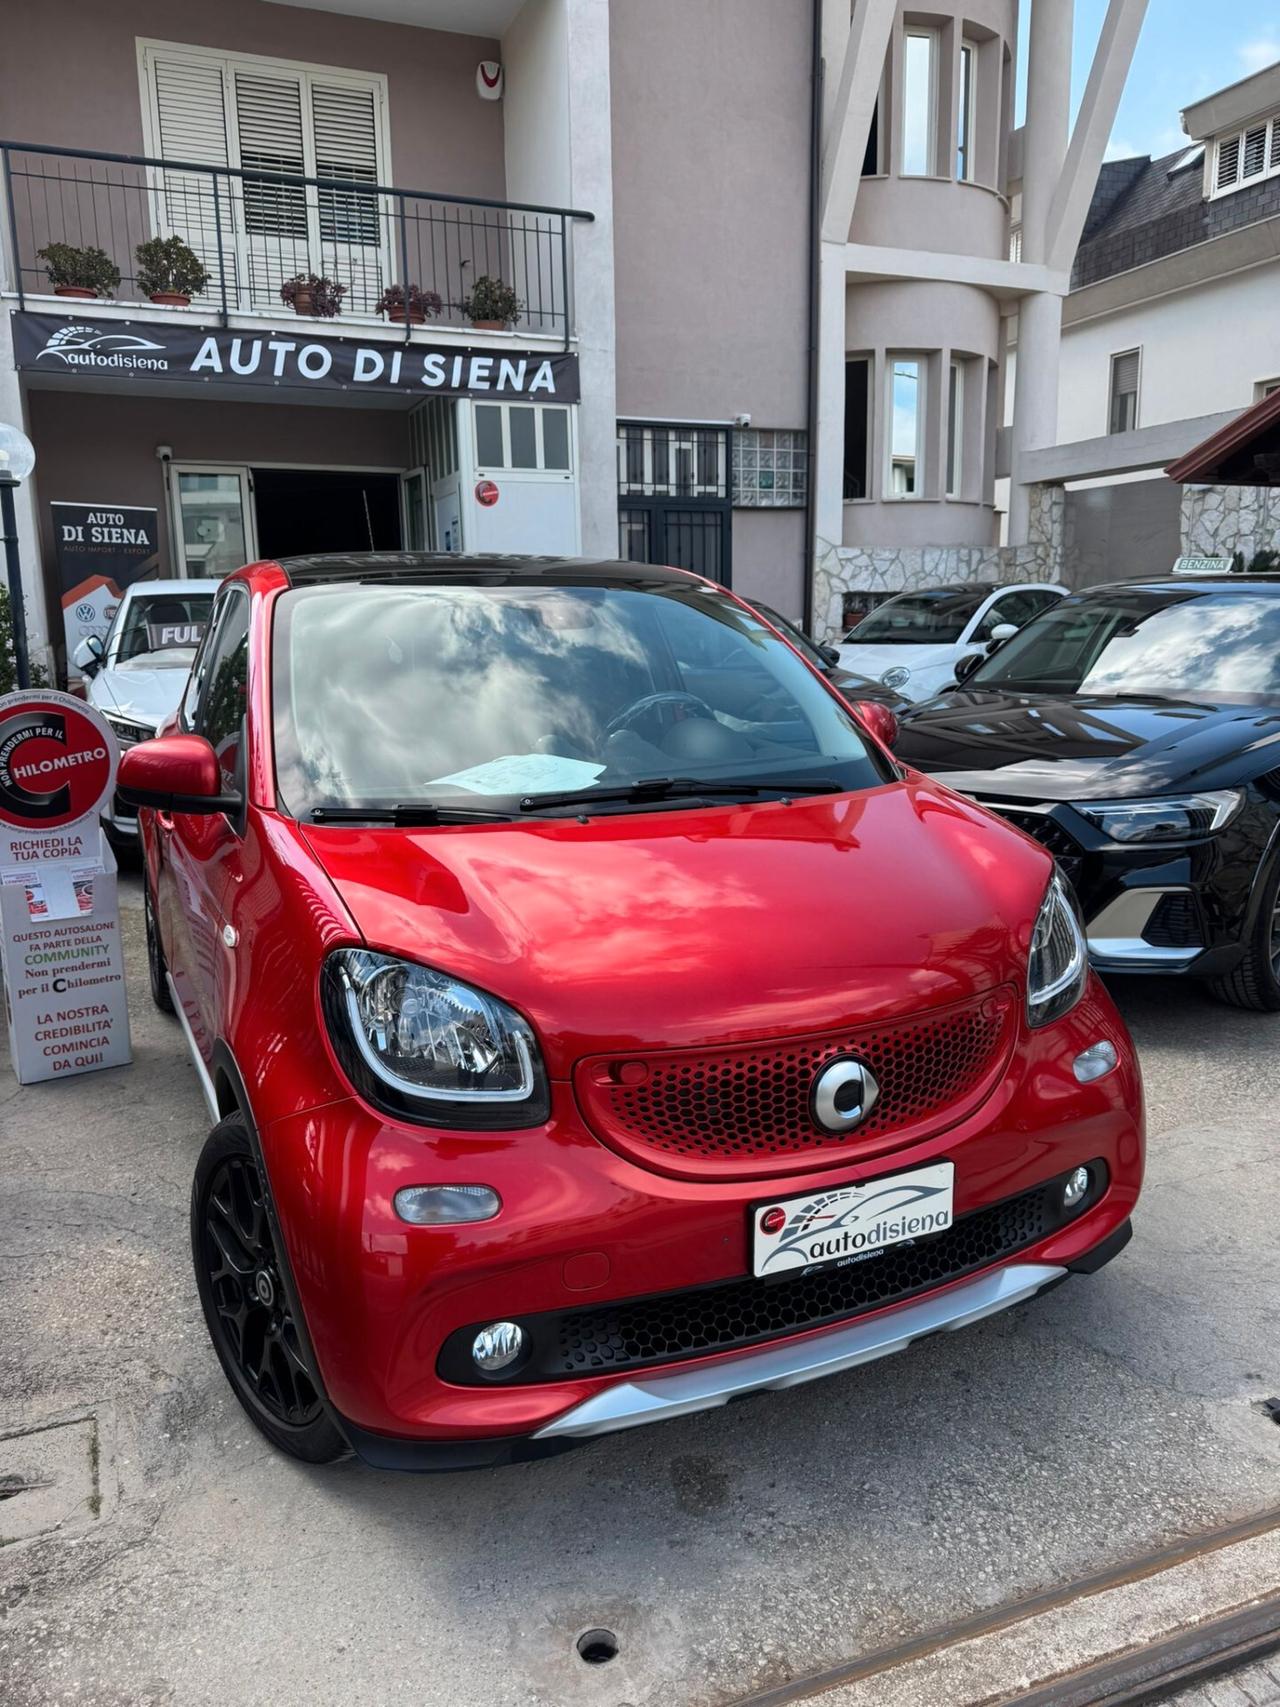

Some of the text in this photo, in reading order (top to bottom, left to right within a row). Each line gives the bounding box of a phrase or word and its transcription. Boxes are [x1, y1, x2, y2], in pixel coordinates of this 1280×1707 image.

[67, 352, 169, 371] autodisiena
[189, 336, 556, 393] AUTO DI SIENA
[87, 512, 125, 526] AUTO
[62, 525, 150, 545] DI SIENA
[1180, 559, 1225, 569] BENZINA
[161, 624, 208, 645] FUL
[0, 729, 34, 767] PRENDERMI
[35, 727, 54, 737] PER
[55, 729, 63, 740] IL
[10, 836, 83, 852] RICHIEDI LA
[13, 847, 81, 861] TUA COPIA
[12, 921, 115, 943] QUESTO AUTOSALONE
[29, 935, 102, 952] FA PARTE DELLA
[24, 944, 110, 966] COMMUNITY
[25, 957, 111, 979] Non prendermi
[18, 974, 121, 999] per il Chilometro
[37, 1004, 109, 1025] LA NOSTRA
[43, 1036, 110, 1057] COMINCIA
[53, 1053, 104, 1072] DA QUI!
[809, 1209, 949, 1259] autodisiena
[836, 1248, 884, 1267] autodisiena
